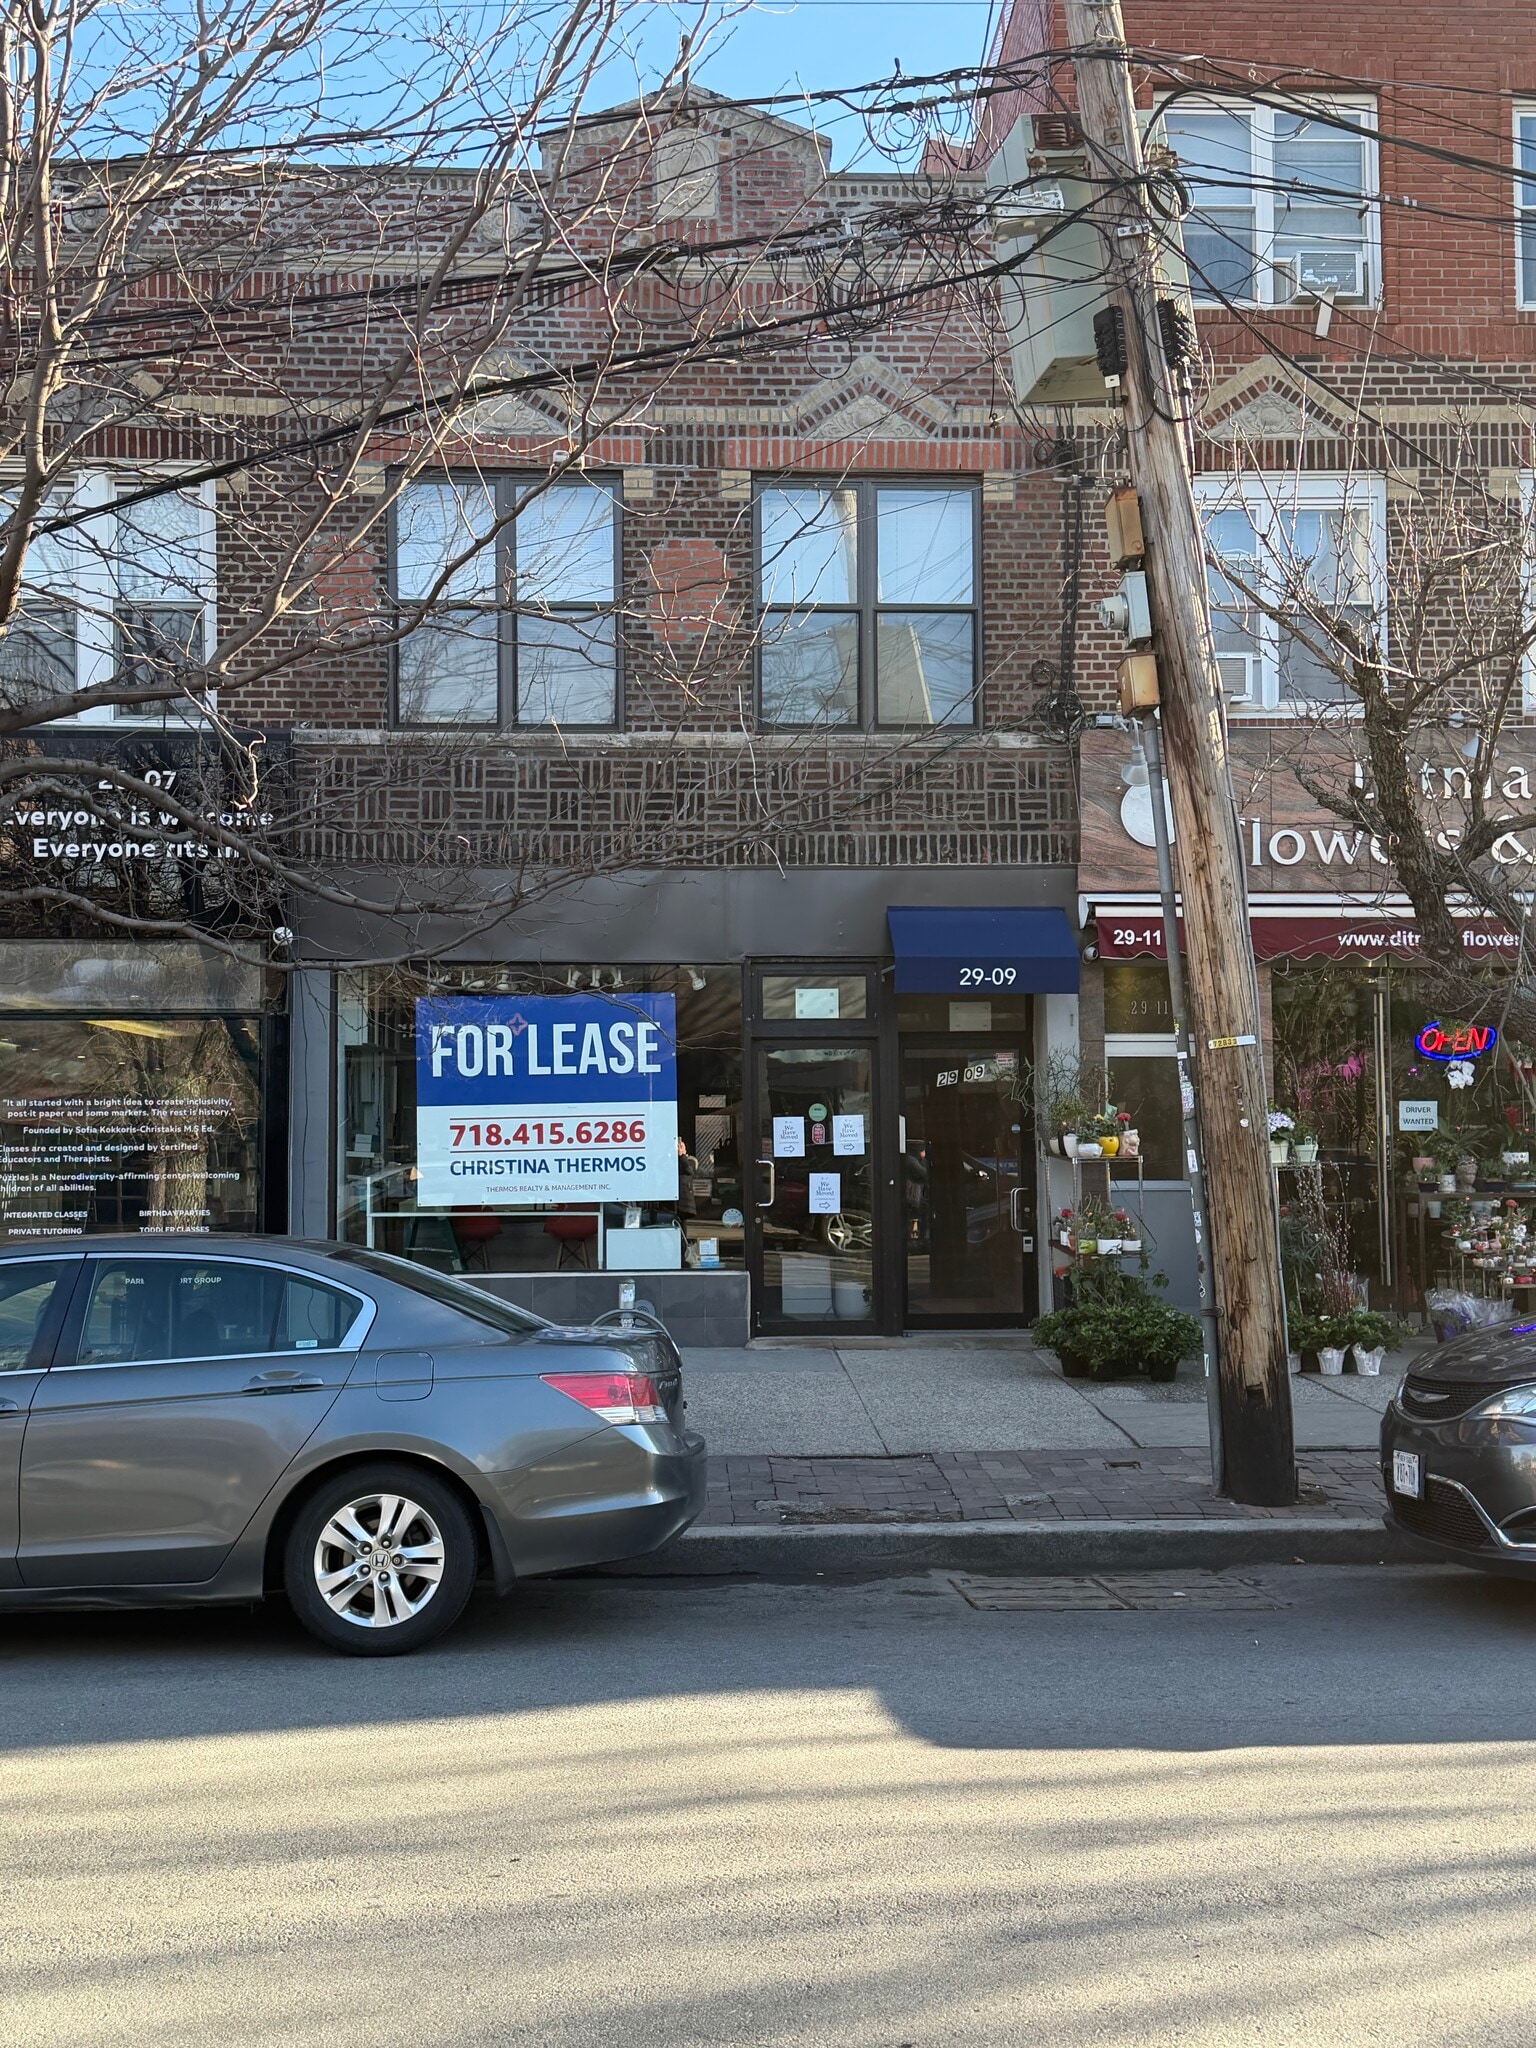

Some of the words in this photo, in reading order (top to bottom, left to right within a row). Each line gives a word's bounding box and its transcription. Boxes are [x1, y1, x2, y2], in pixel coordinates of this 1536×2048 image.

[131, 805, 150, 825] is
[33, 838, 156, 862] Everyone
[1113, 929, 1161, 945] 29-11
[959, 967, 1017, 985] 29-09
[1420, 1026, 1489, 1051] OPEN
[431, 1023, 514, 1077] FOR
[527, 1021, 662, 1075] LEASE
[937, 1071, 957, 1086] 29
[965, 1065, 983, 1080] 09
[16, 1099, 27, 1107] all
[29, 1099, 62, 1107] started
[64, 1098, 84, 1107] with
[94, 1098, 121, 1108] bright
[123, 1098, 142, 1106] idea
[39, 1110, 65, 1119] paper
[67, 1109, 84, 1117] and
[85, 1109, 109, 1117] some
[111, 1109, 149, 1117] markers.
[151, 1108, 168, 1117] The
[169, 1108, 190, 1116] rest
[190, 1108, 197, 1116] is
[1405, 1106, 1431, 1114] DRIVER
[1403, 1118, 1434, 1126] WANTED
[23, 1126, 61, 1134] Founded
[62, 1126, 73, 1136] by
[75, 1126, 98, 1134] Sofia
[449, 1119, 646, 1147] 718.415.6286
[31, 1145, 47, 1153] are
[48, 1144, 83, 1152] created
[85, 1144, 102, 1152] and
[104, 1143, 145, 1153] designed
[147, 1143, 158, 1153] by
[160, 1143, 198, 1152] certified
[43, 1155, 60, 1163] and
[63, 1155, 112, 1165] Therapists.
[450, 1158, 550, 1176] CHRISTINA
[554, 1156, 646, 1174] THERMOS
[32, 1173, 39, 1181] is
[49, 1171, 160, 1182] Neurodiversity-affirming
[34, 1183, 45, 1192] of
[45, 1183, 57, 1192] all
[59, 1183, 97, 1192] abilities.
[486, 1185, 519, 1193] THERMOS
[519, 1184, 544, 1192] REALTY
[544, 1184, 550, 1192] &
[551, 1183, 598, 1192] MANAGEMENT
[4, 1210, 53, 1219] INTEGRATED
[54, 1210, 88, 1218] CLASSES
[179, 1209, 210, 1217] PARTIES
[8, 1228, 41, 1236] PRIVATE
[43, 1227, 83, 1235] TUTORING
[193, 1277, 222, 1285] GROUP
